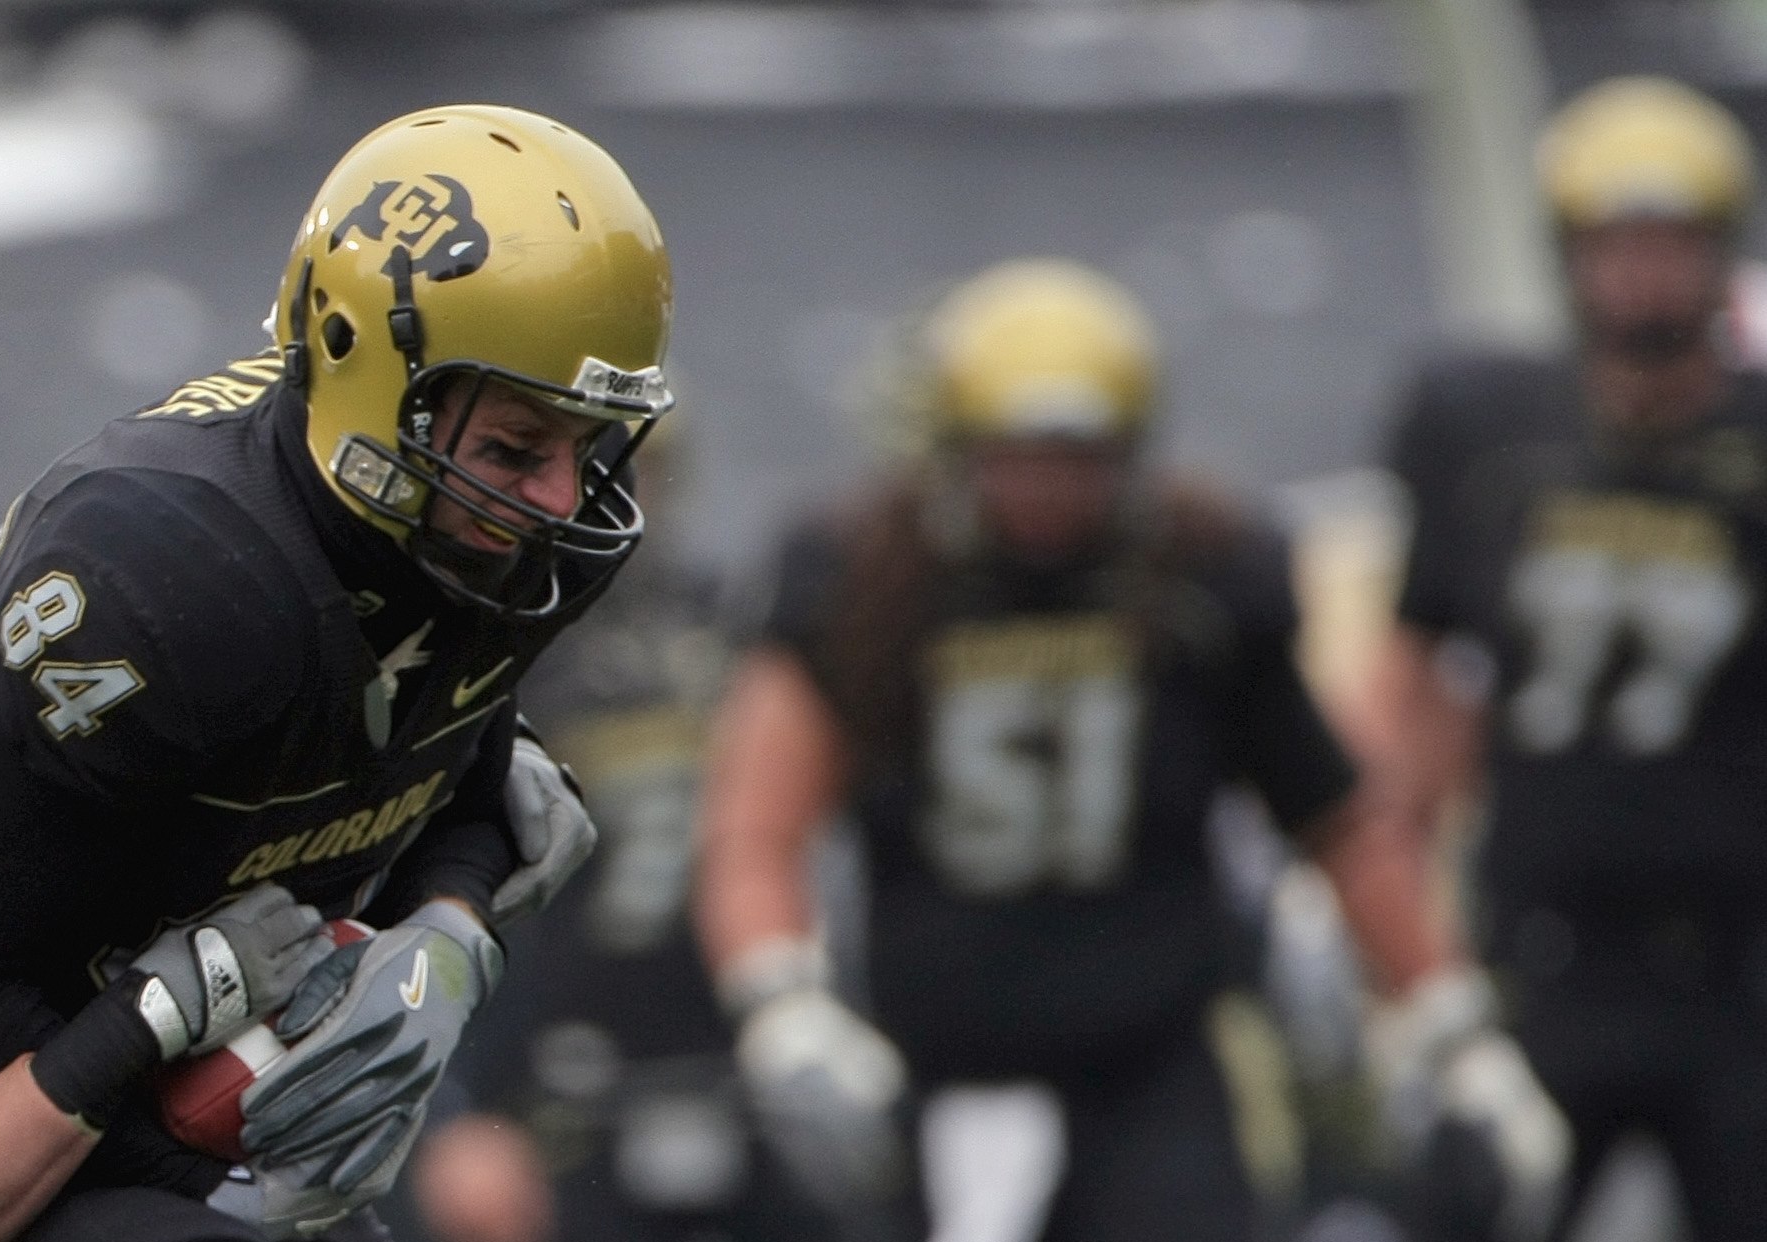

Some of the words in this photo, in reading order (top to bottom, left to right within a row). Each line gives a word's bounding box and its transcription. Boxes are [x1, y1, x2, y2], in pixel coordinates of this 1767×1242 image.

[0, 570, 147, 742] 84
[1511, 540, 1753, 757] 77
[918, 675, 1140, 898] 51
